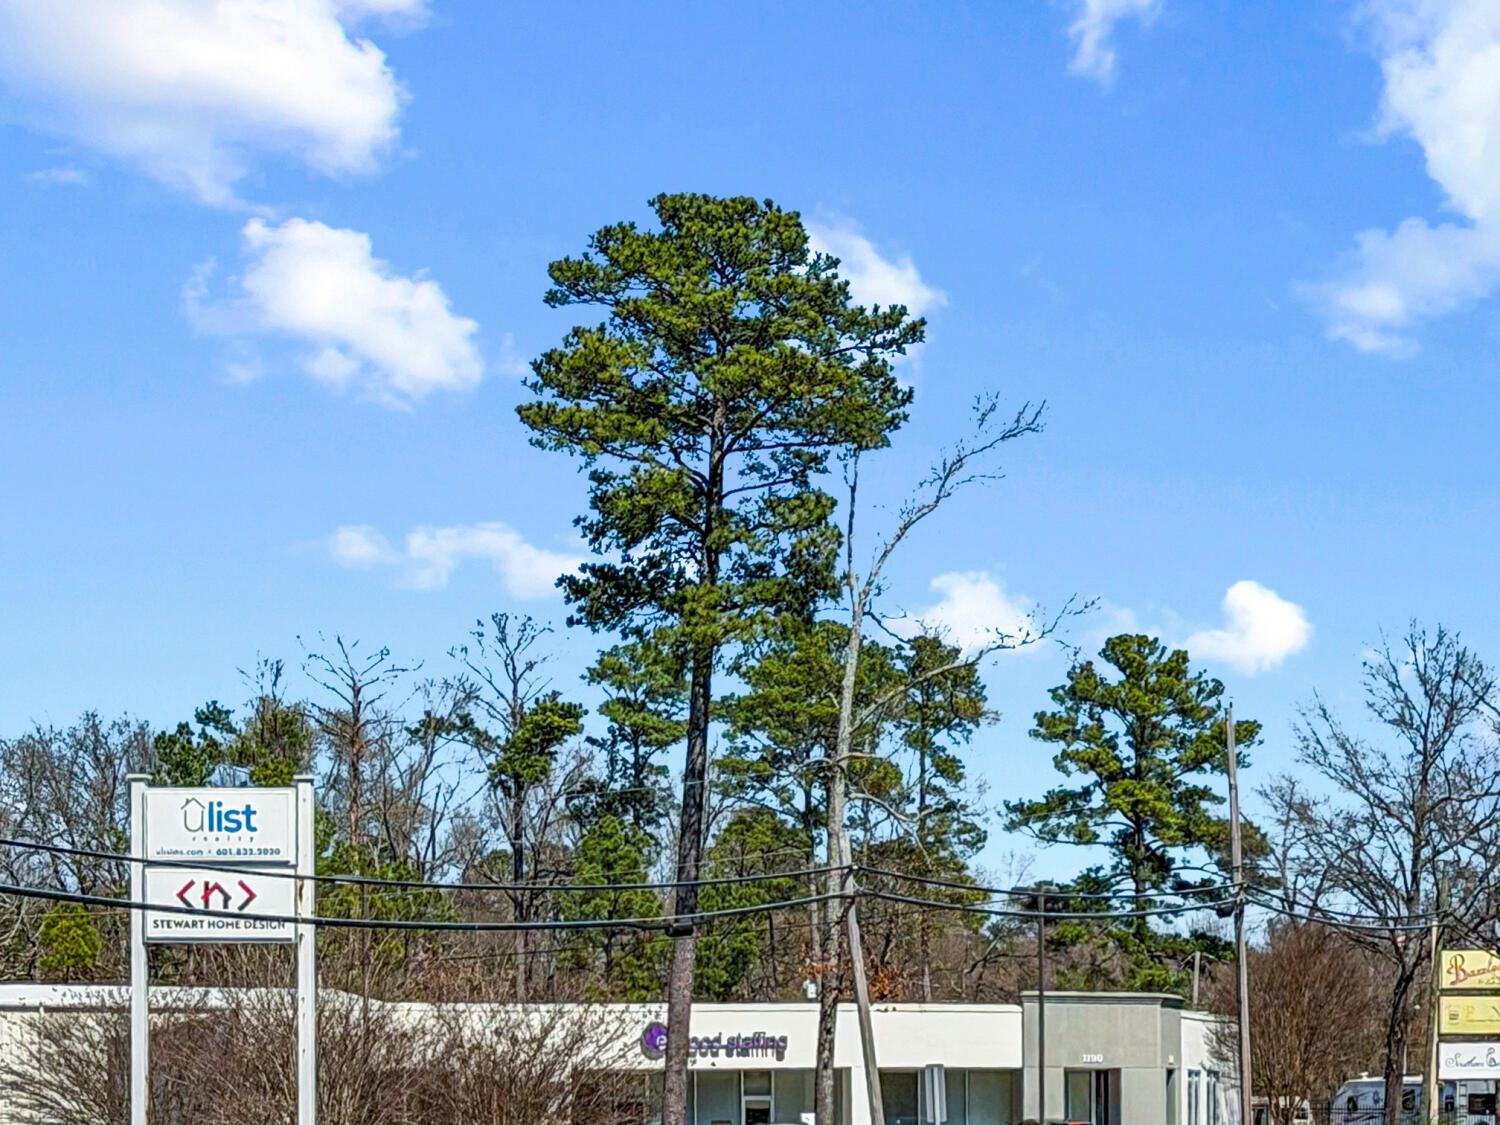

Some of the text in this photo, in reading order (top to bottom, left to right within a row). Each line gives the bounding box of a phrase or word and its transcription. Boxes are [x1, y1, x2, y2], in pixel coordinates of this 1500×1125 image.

[184, 800, 258, 833] ulist
[153, 919, 286, 930] STEWART HOME DESIGN
[725, 1030, 788, 1061] staffing
